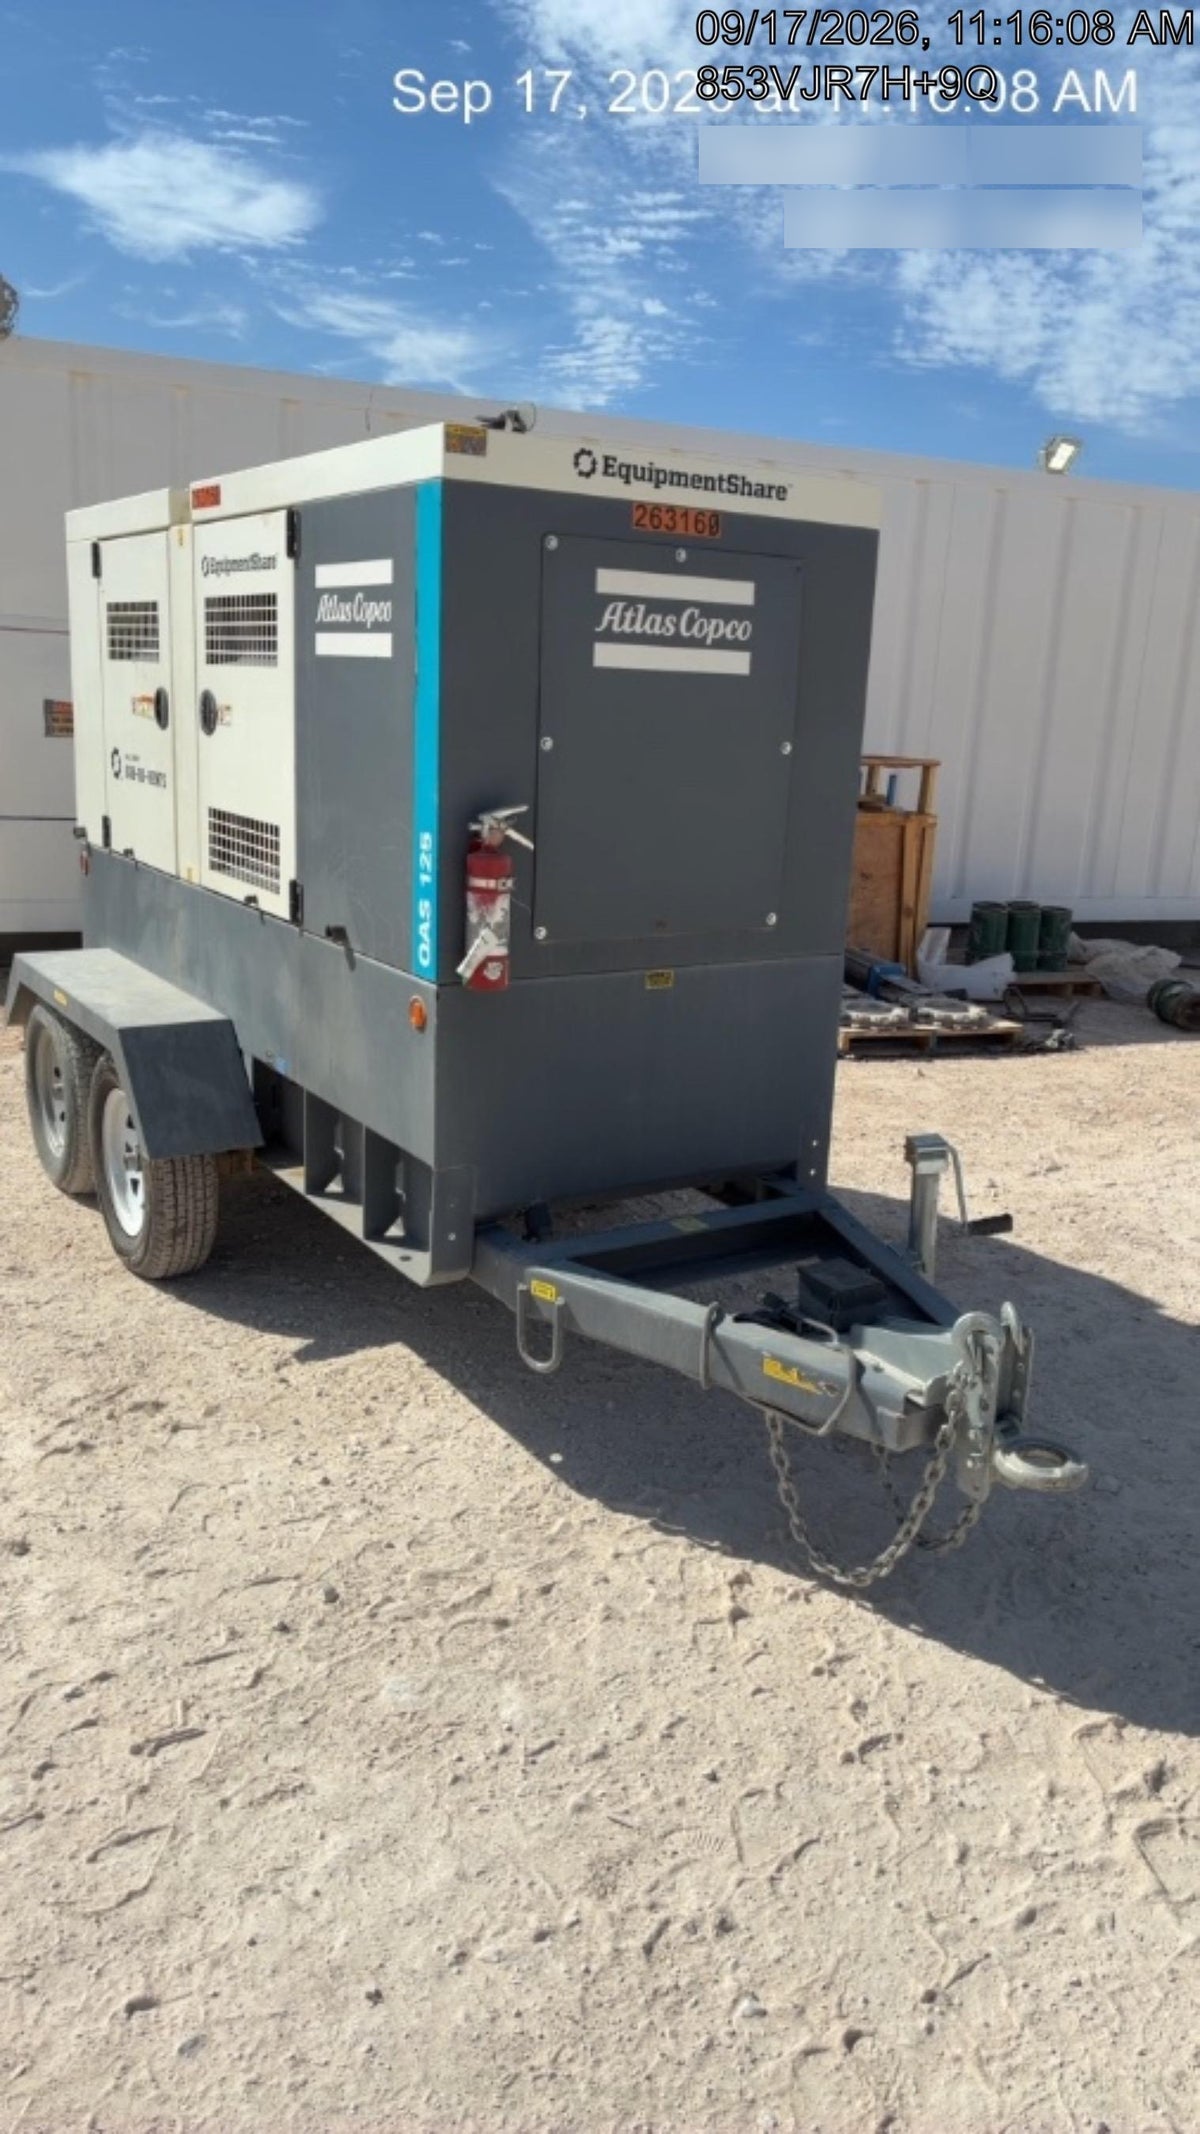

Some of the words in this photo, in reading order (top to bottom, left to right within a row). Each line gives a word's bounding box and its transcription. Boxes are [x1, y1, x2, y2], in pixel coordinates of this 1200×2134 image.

[602, 455, 788, 501] EquipmentShare
[314, 593, 352, 623] Atlas
[353, 591, 392, 629] Copco
[594, 601, 677, 637] Atlas
[679, 606, 753, 646] Copco
